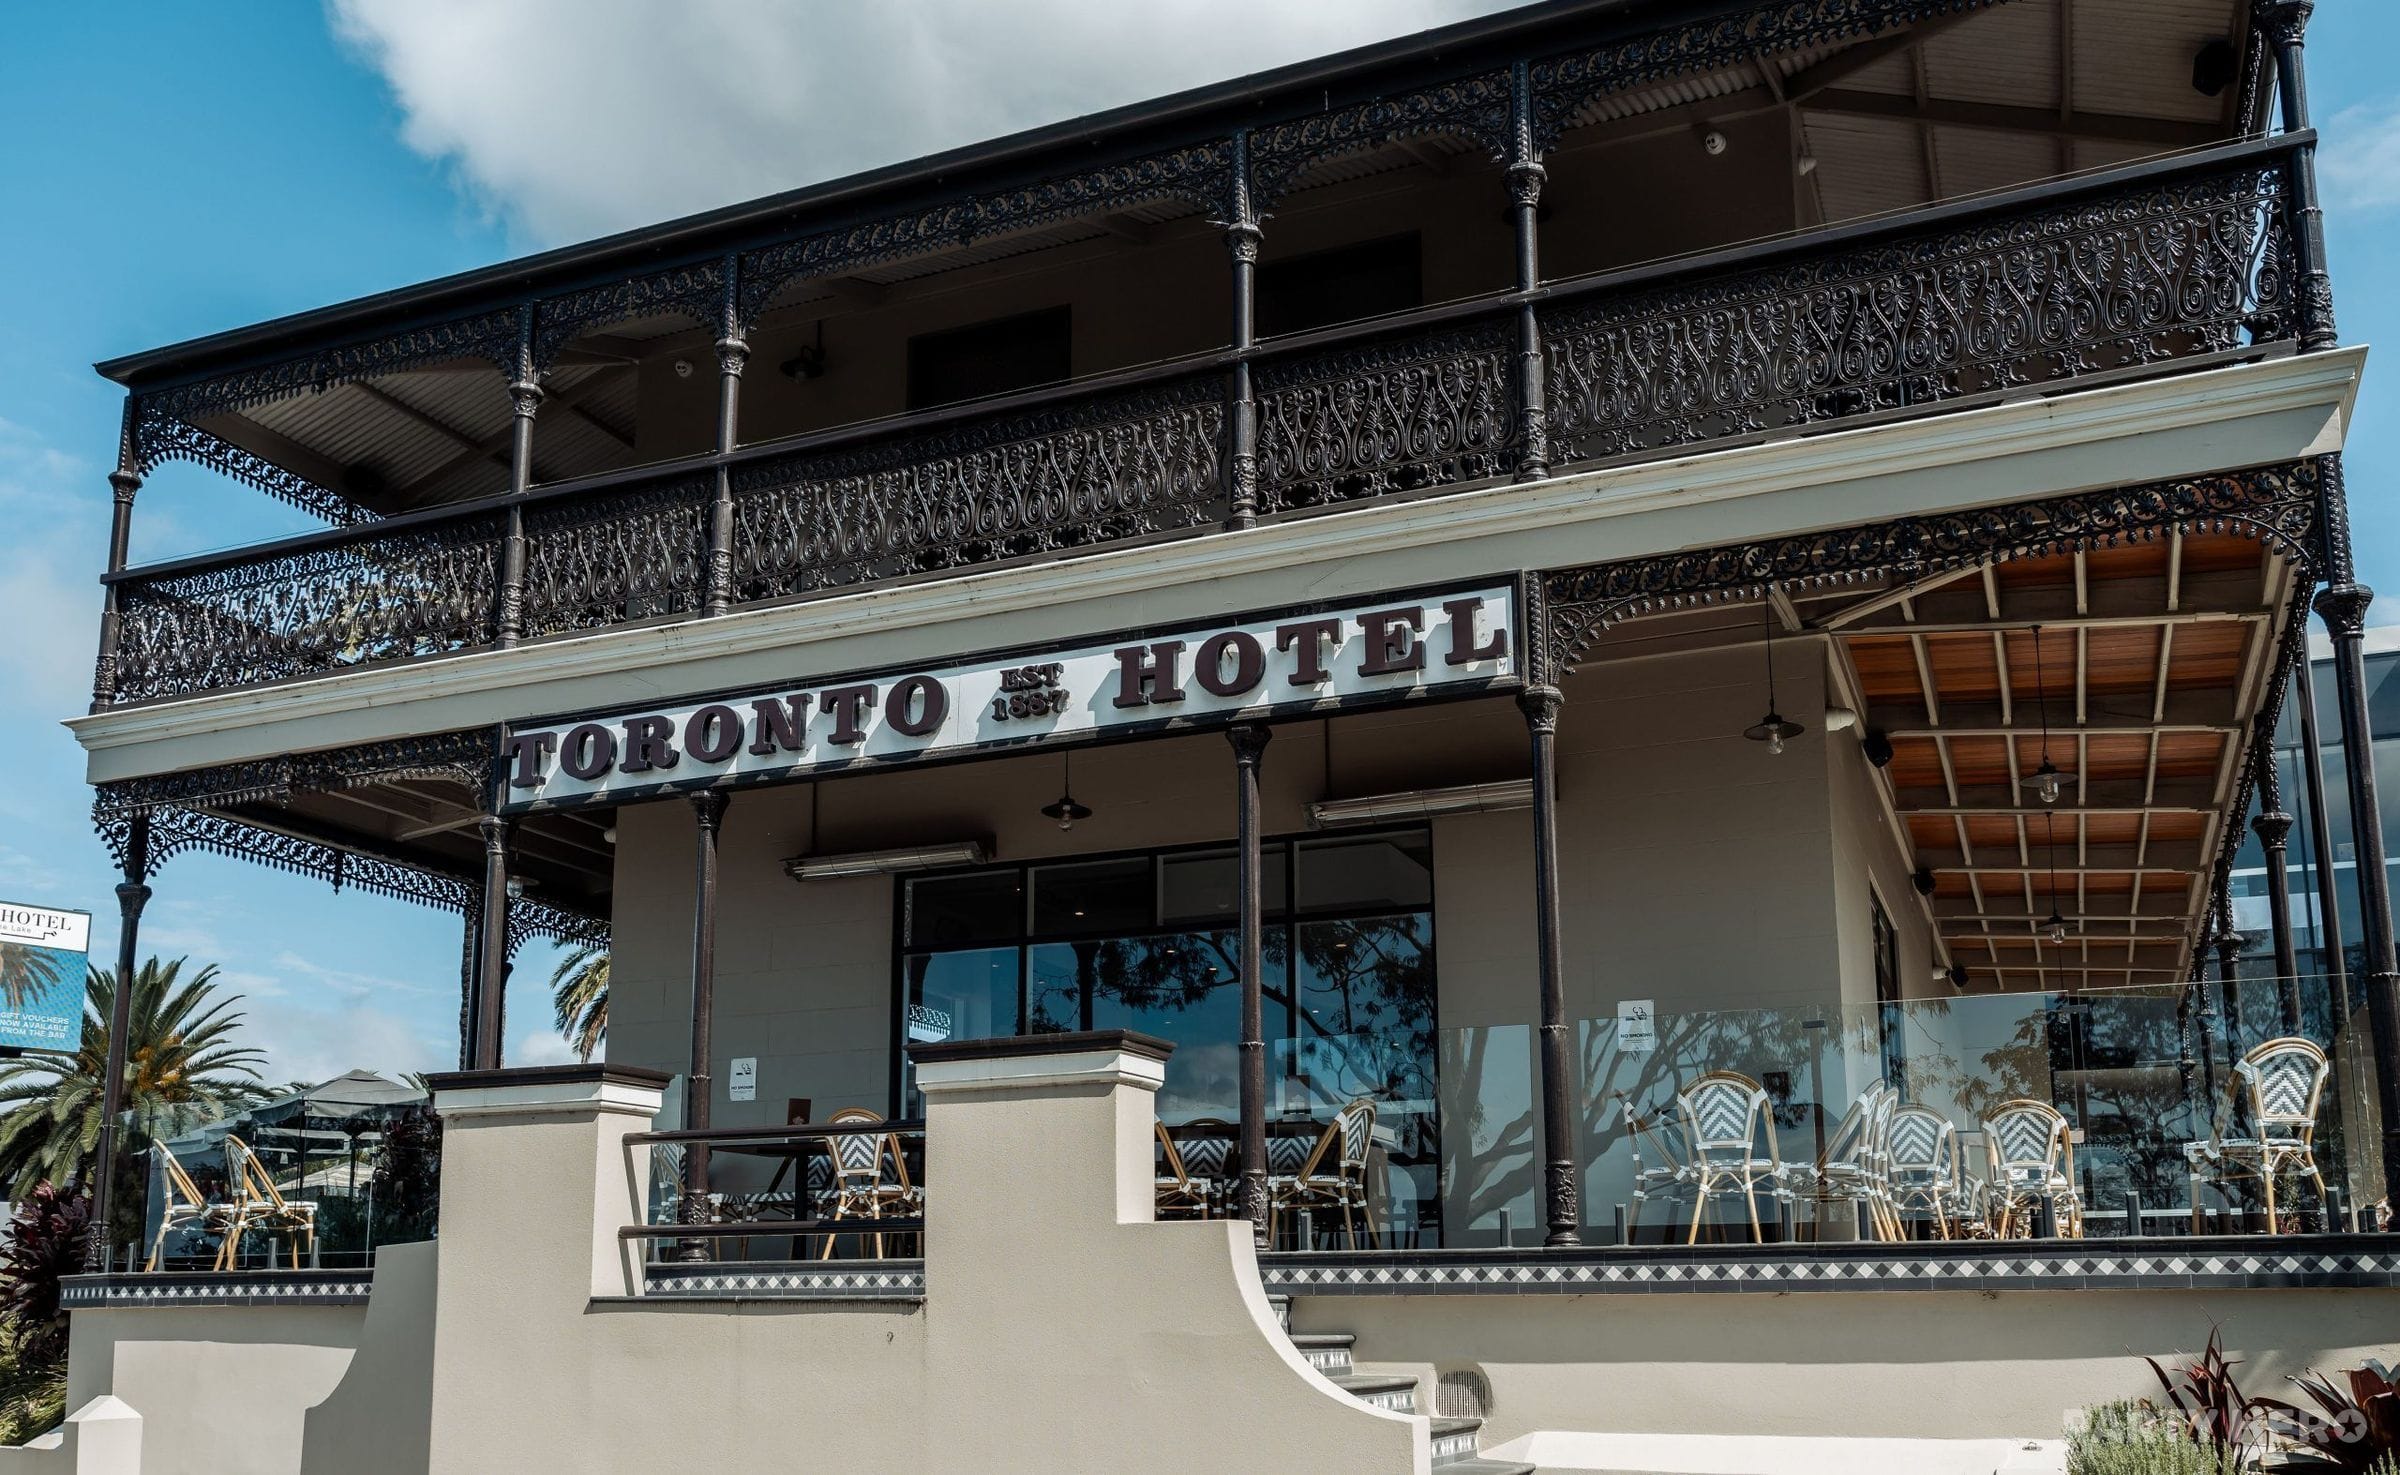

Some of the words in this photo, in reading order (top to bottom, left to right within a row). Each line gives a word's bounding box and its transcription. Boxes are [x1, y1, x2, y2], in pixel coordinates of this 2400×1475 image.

[1000, 662, 1064, 693] EST
[504, 674, 950, 788] TORONTO
[1113, 596, 1508, 709] HOTEL
[991, 688, 1072, 721] 1887
[1, 909, 72, 931] HOTEL
[0, 1019, 20, 1027] NOW
[23, 1021, 69, 1032] AVAILABLE
[1, 1012, 20, 1020] GIFT
[23, 1014, 70, 1025] VOUCHERS
[1, 1026, 26, 1035] FROM
[29, 1029, 46, 1037] THE
[48, 1031, 66, 1039] BAR
